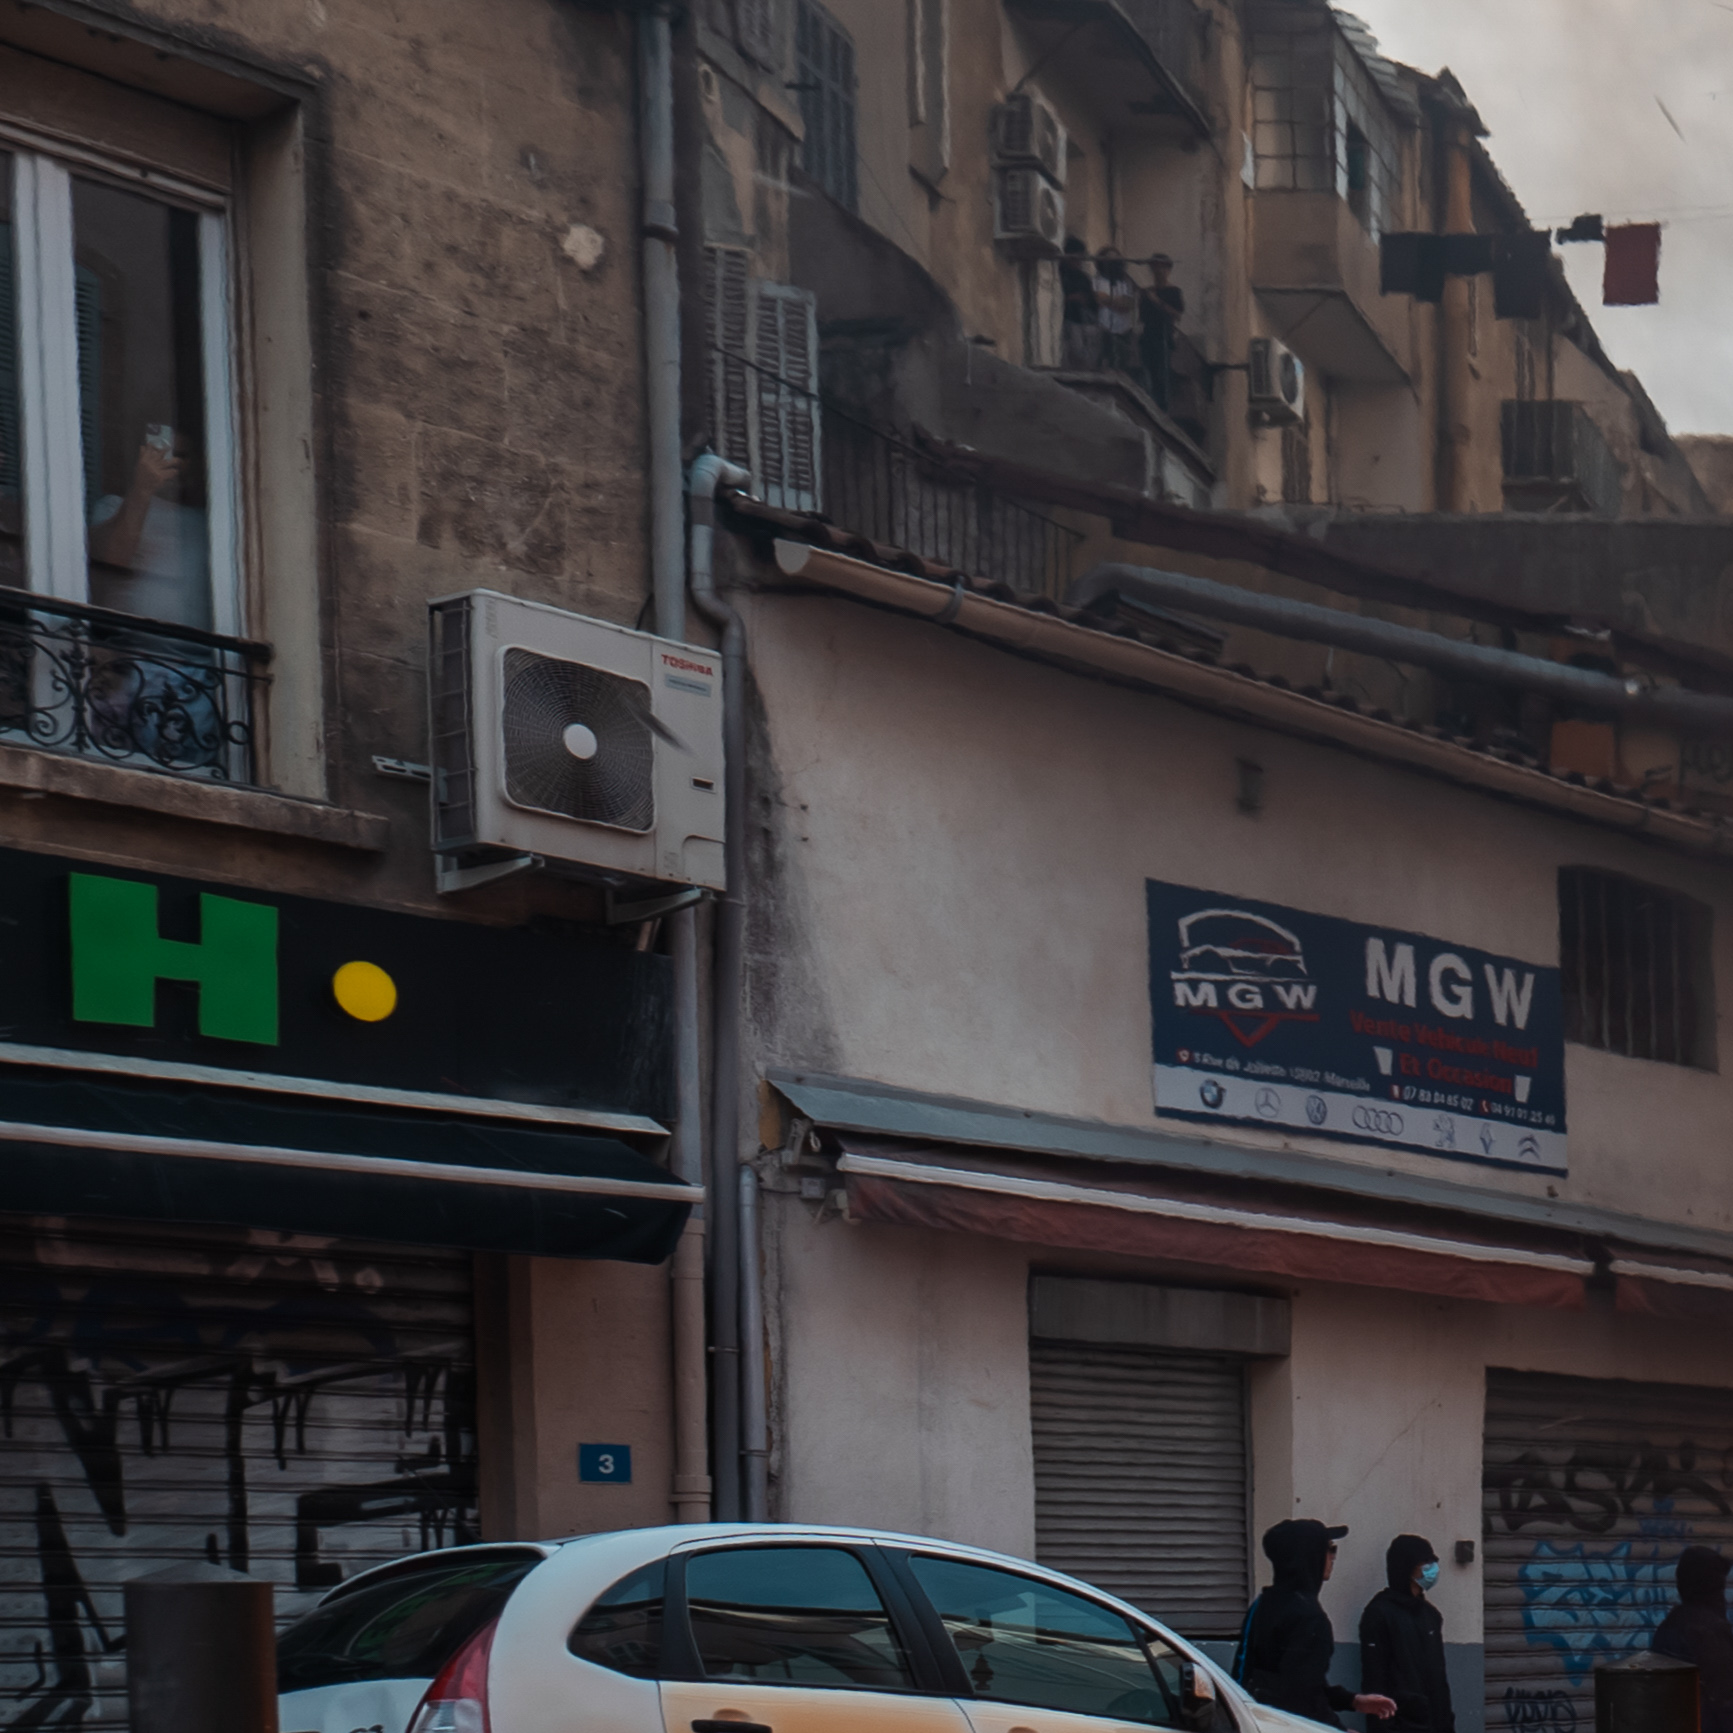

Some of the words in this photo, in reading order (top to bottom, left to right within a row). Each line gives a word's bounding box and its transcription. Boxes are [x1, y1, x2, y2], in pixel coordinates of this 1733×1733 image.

[661, 654, 713, 676] TOSHIBA
[69, 871, 280, 1046] H
[1365, 935, 1535, 1030] MGW
[1349, 1009, 1411, 1042] Vente
[1399, 1053, 1421, 1077] Et
[1427, 1056, 1513, 1095] Occasion
[1403, 1085, 1417, 1100] 07
[598, 1454, 615, 1474] 3
